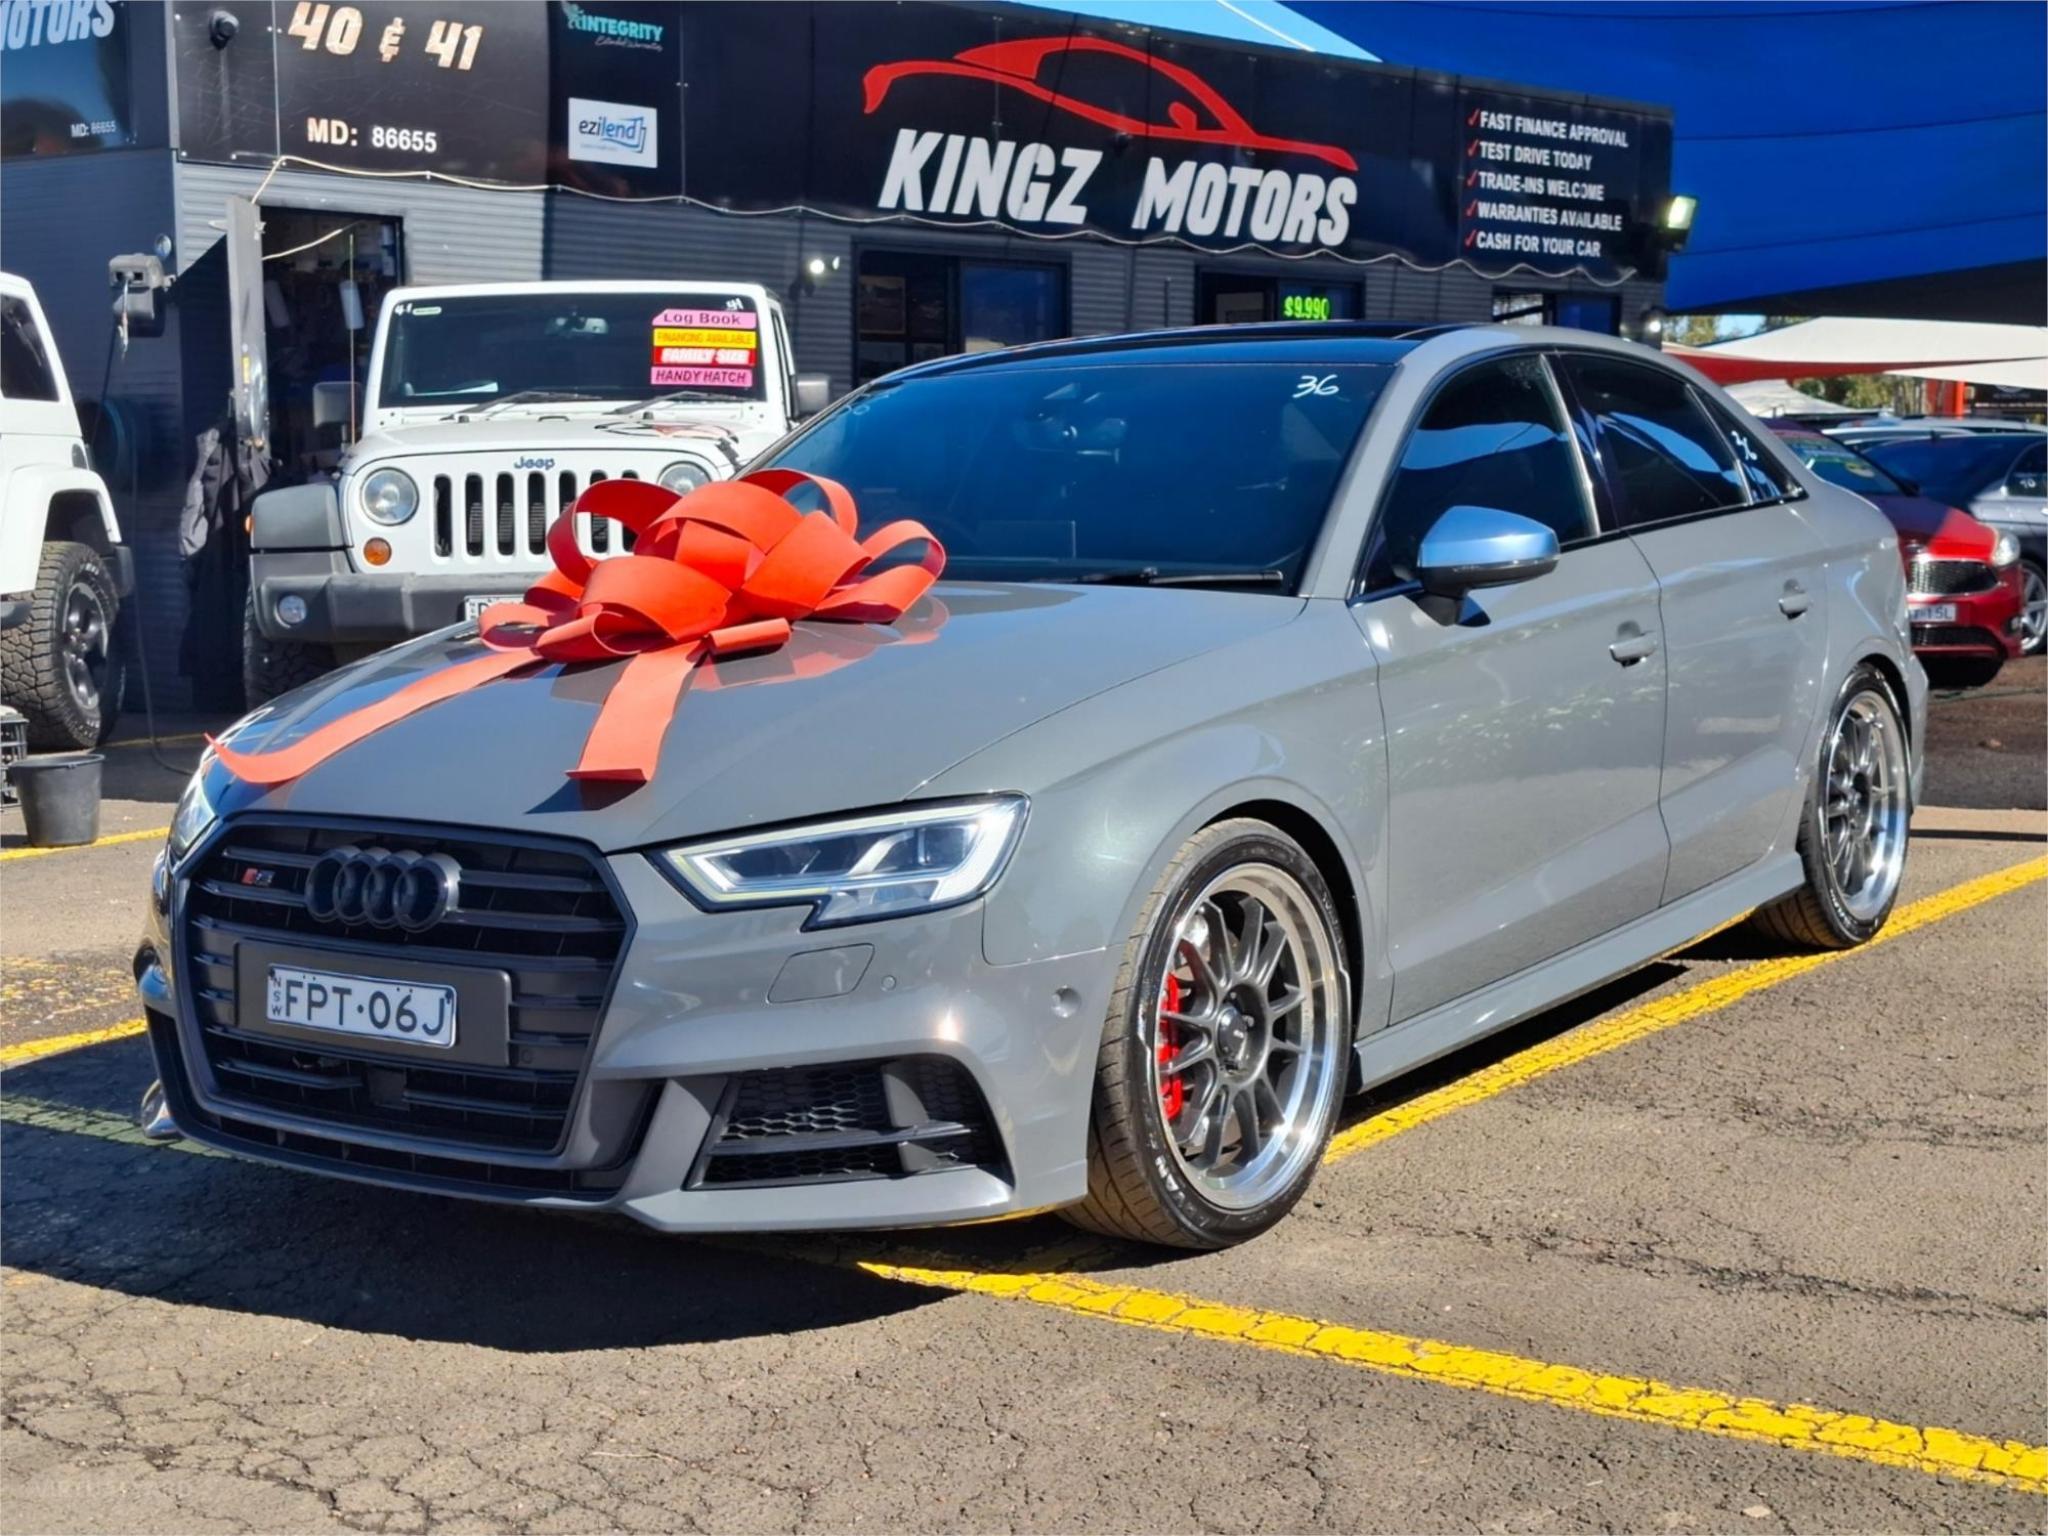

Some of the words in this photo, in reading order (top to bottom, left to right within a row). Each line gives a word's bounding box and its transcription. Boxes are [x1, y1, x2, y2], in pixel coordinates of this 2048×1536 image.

[288, 2, 363, 55] 40
[425, 20, 483, 70] 41
[581, 14, 664, 42] INTEGRITY
[307, 117, 358, 146] MD:
[372, 125, 438, 152] 86655
[579, 116, 639, 140] ezilend
[1480, 111, 1512, 131] FAST
[1515, 116, 1567, 139] FINANCE
[1569, 124, 1629, 147] APPROVAL
[1480, 141, 1511, 161] TEST
[1514, 146, 1550, 166] DRIVE
[1553, 151, 1592, 171] TODAY
[877, 128, 1102, 224] KINGZ
[1131, 157, 1358, 246] MOTORS
[1479, 171, 1545, 195] TRADE-INS
[1547, 179, 1605, 201] WELCOME
[1478, 202, 1558, 225] WARRANTIES
[1560, 210, 1623, 231] AVAILABLE
[1476, 231, 1511, 250] CASH
[1514, 235, 1539, 253] FOR
[1542, 237, 1574, 255] YOUR
[1577, 240, 1601, 257] CAR
[664, 313, 693, 324] Log
[699, 313, 741, 325] Book
[706, 332, 752, 345] AVAILABLE
[656, 370, 702, 382] HANDY
[703, 371, 747, 384] HATCH
[1292, 374, 1339, 398] 36
[514, 455, 556, 471] Jeep
